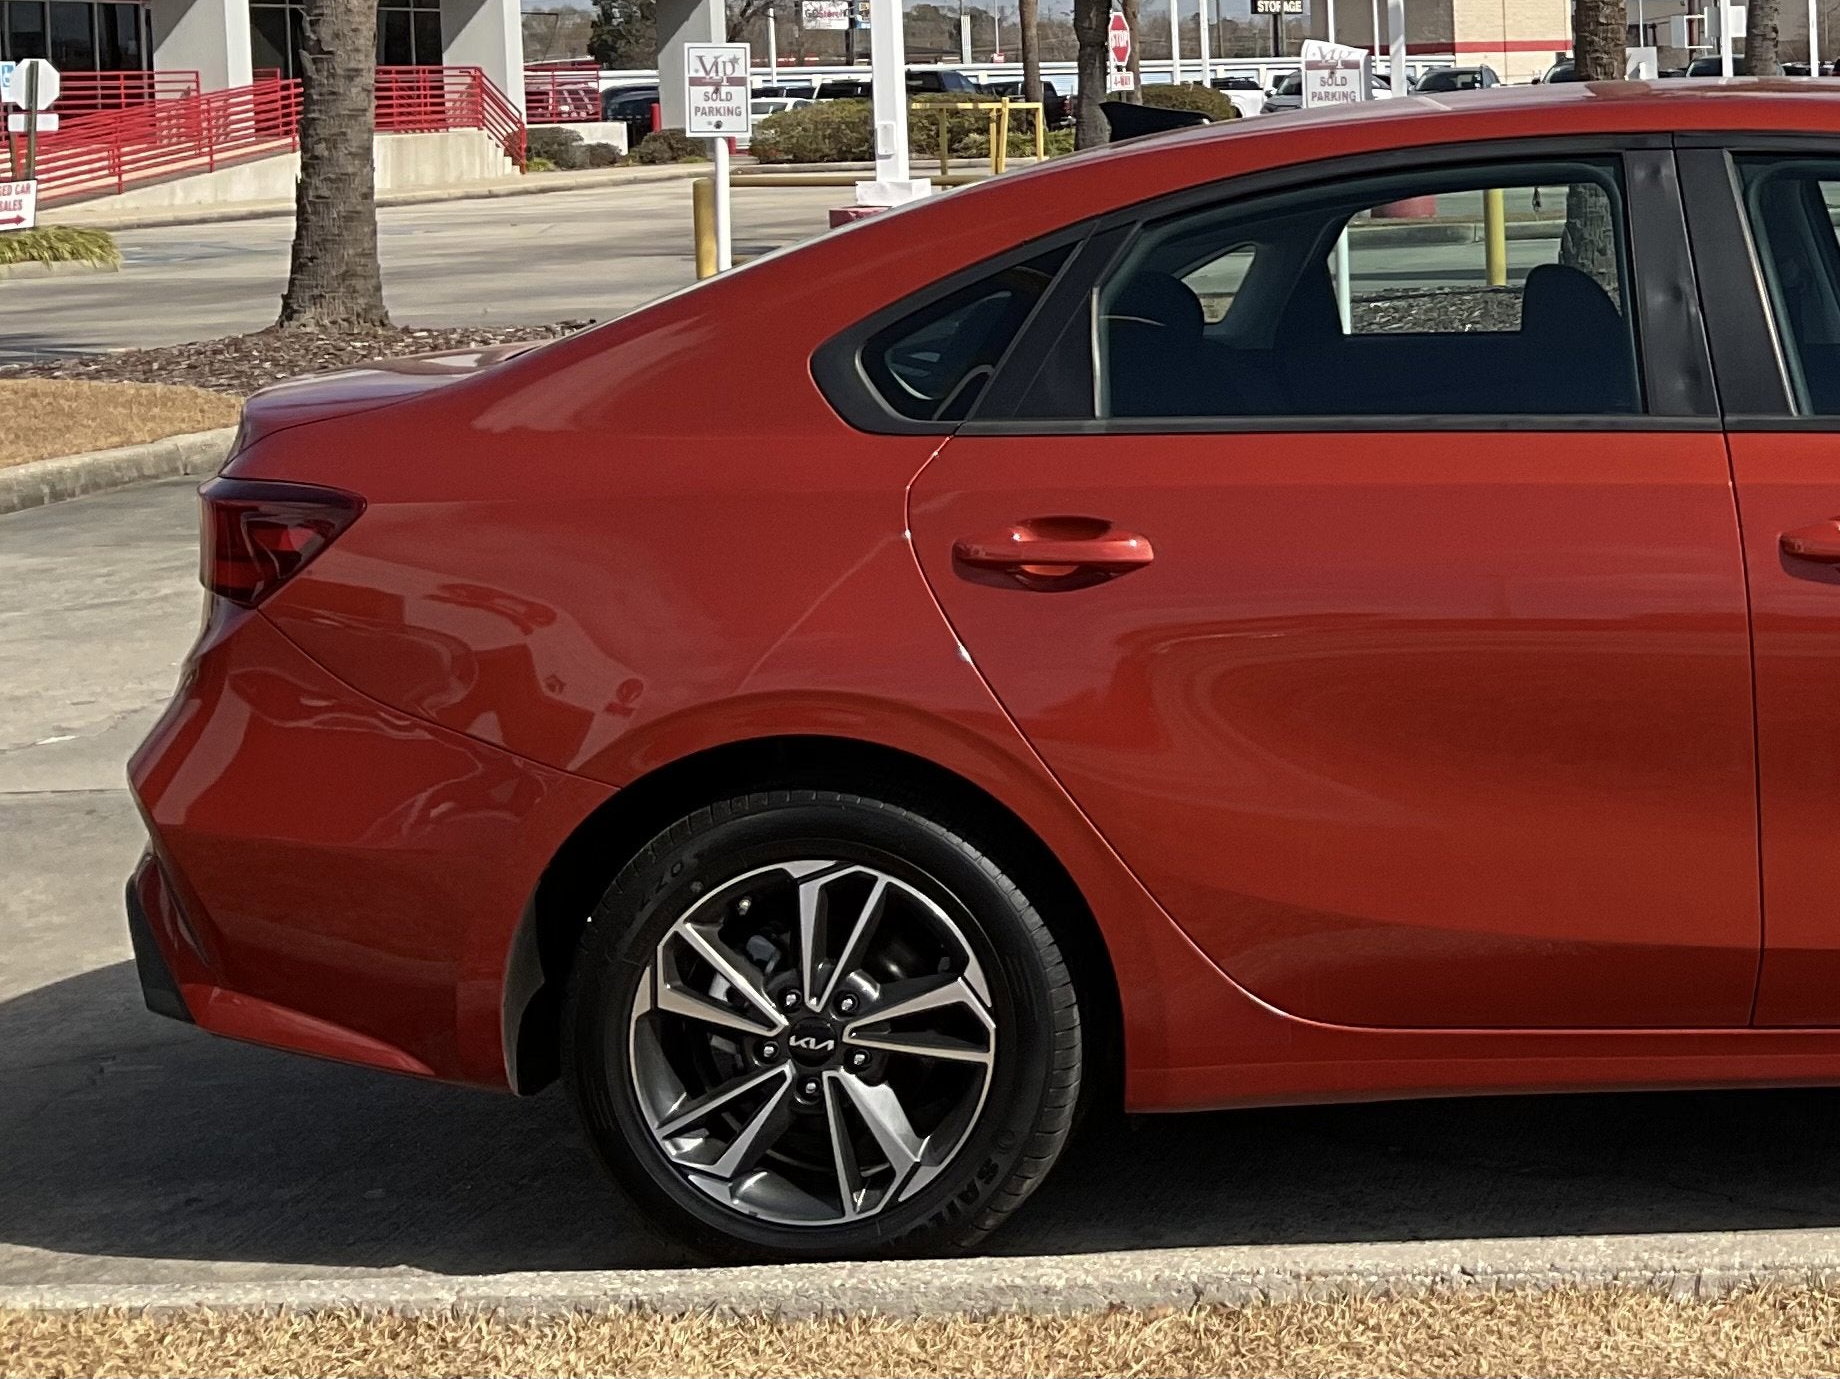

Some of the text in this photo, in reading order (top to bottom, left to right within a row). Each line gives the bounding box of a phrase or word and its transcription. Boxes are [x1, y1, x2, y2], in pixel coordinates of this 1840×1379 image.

[1110, 31, 1129, 48] STOP
[1320, 76, 1348, 87] SOLD
[703, 91, 733, 102] SOLD
[1311, 91, 1357, 102] PARKING
[694, 106, 742, 117] PARKING
[15, 182, 31, 195] CAR
